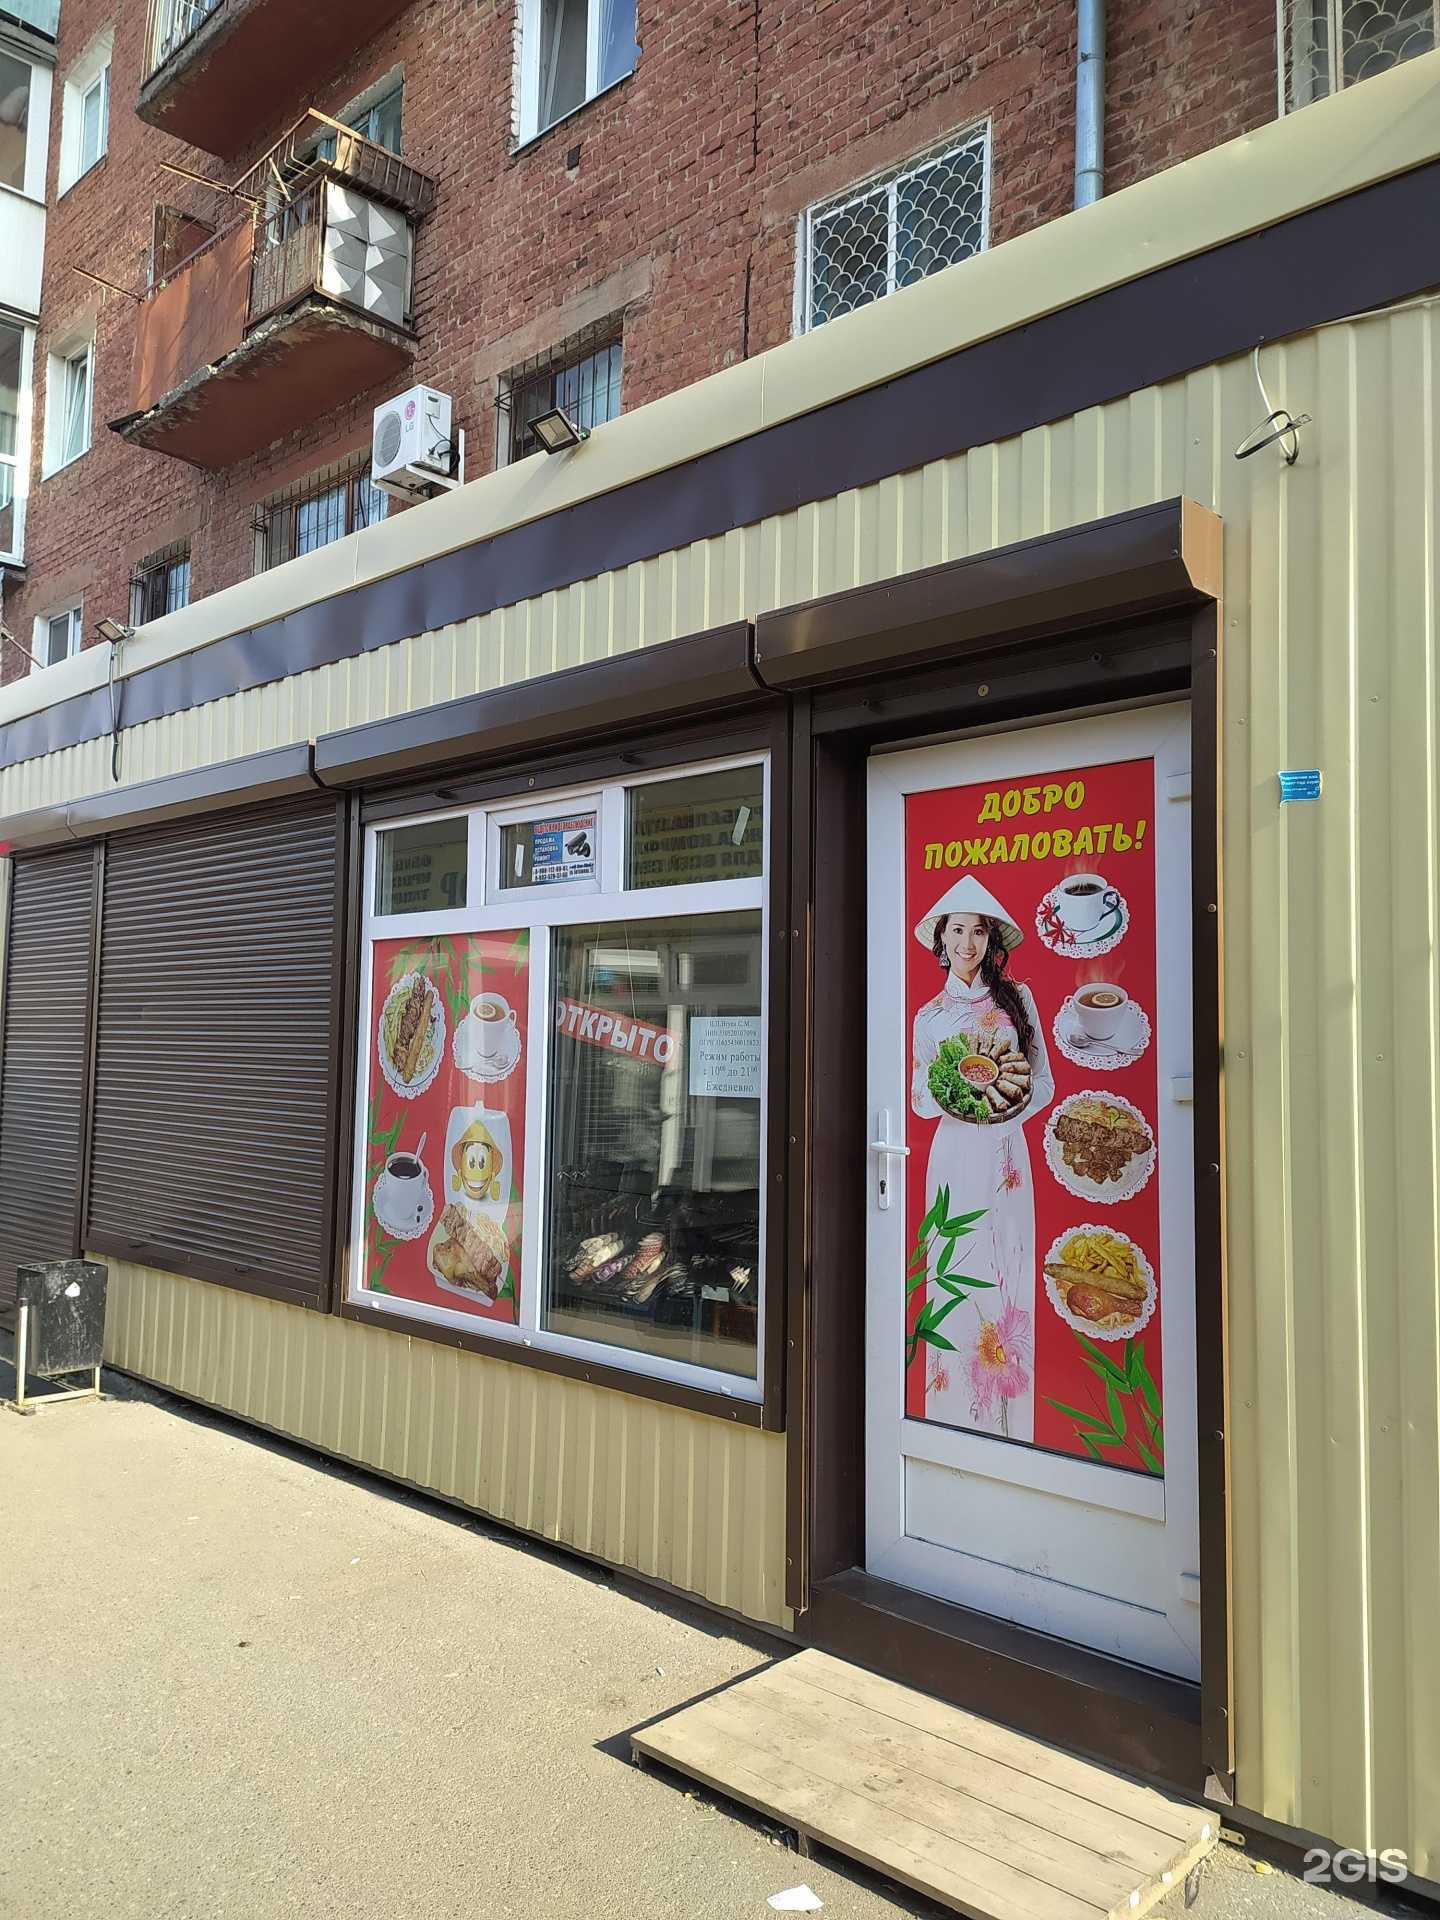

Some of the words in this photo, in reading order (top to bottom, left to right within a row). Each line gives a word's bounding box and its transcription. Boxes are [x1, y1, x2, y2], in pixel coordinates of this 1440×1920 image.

[405, 421, 414, 433] LG
[977, 780, 1085, 824] ДОБРО
[924, 820, 1147, 870] ПОЖАЛОВАТЬ!
[700, 1050, 727, 1061] Режим
[730, 1050, 760, 1063] работы
[727, 1069, 738, 1077] до
[706, 1080, 754, 1092] Ежедневно
